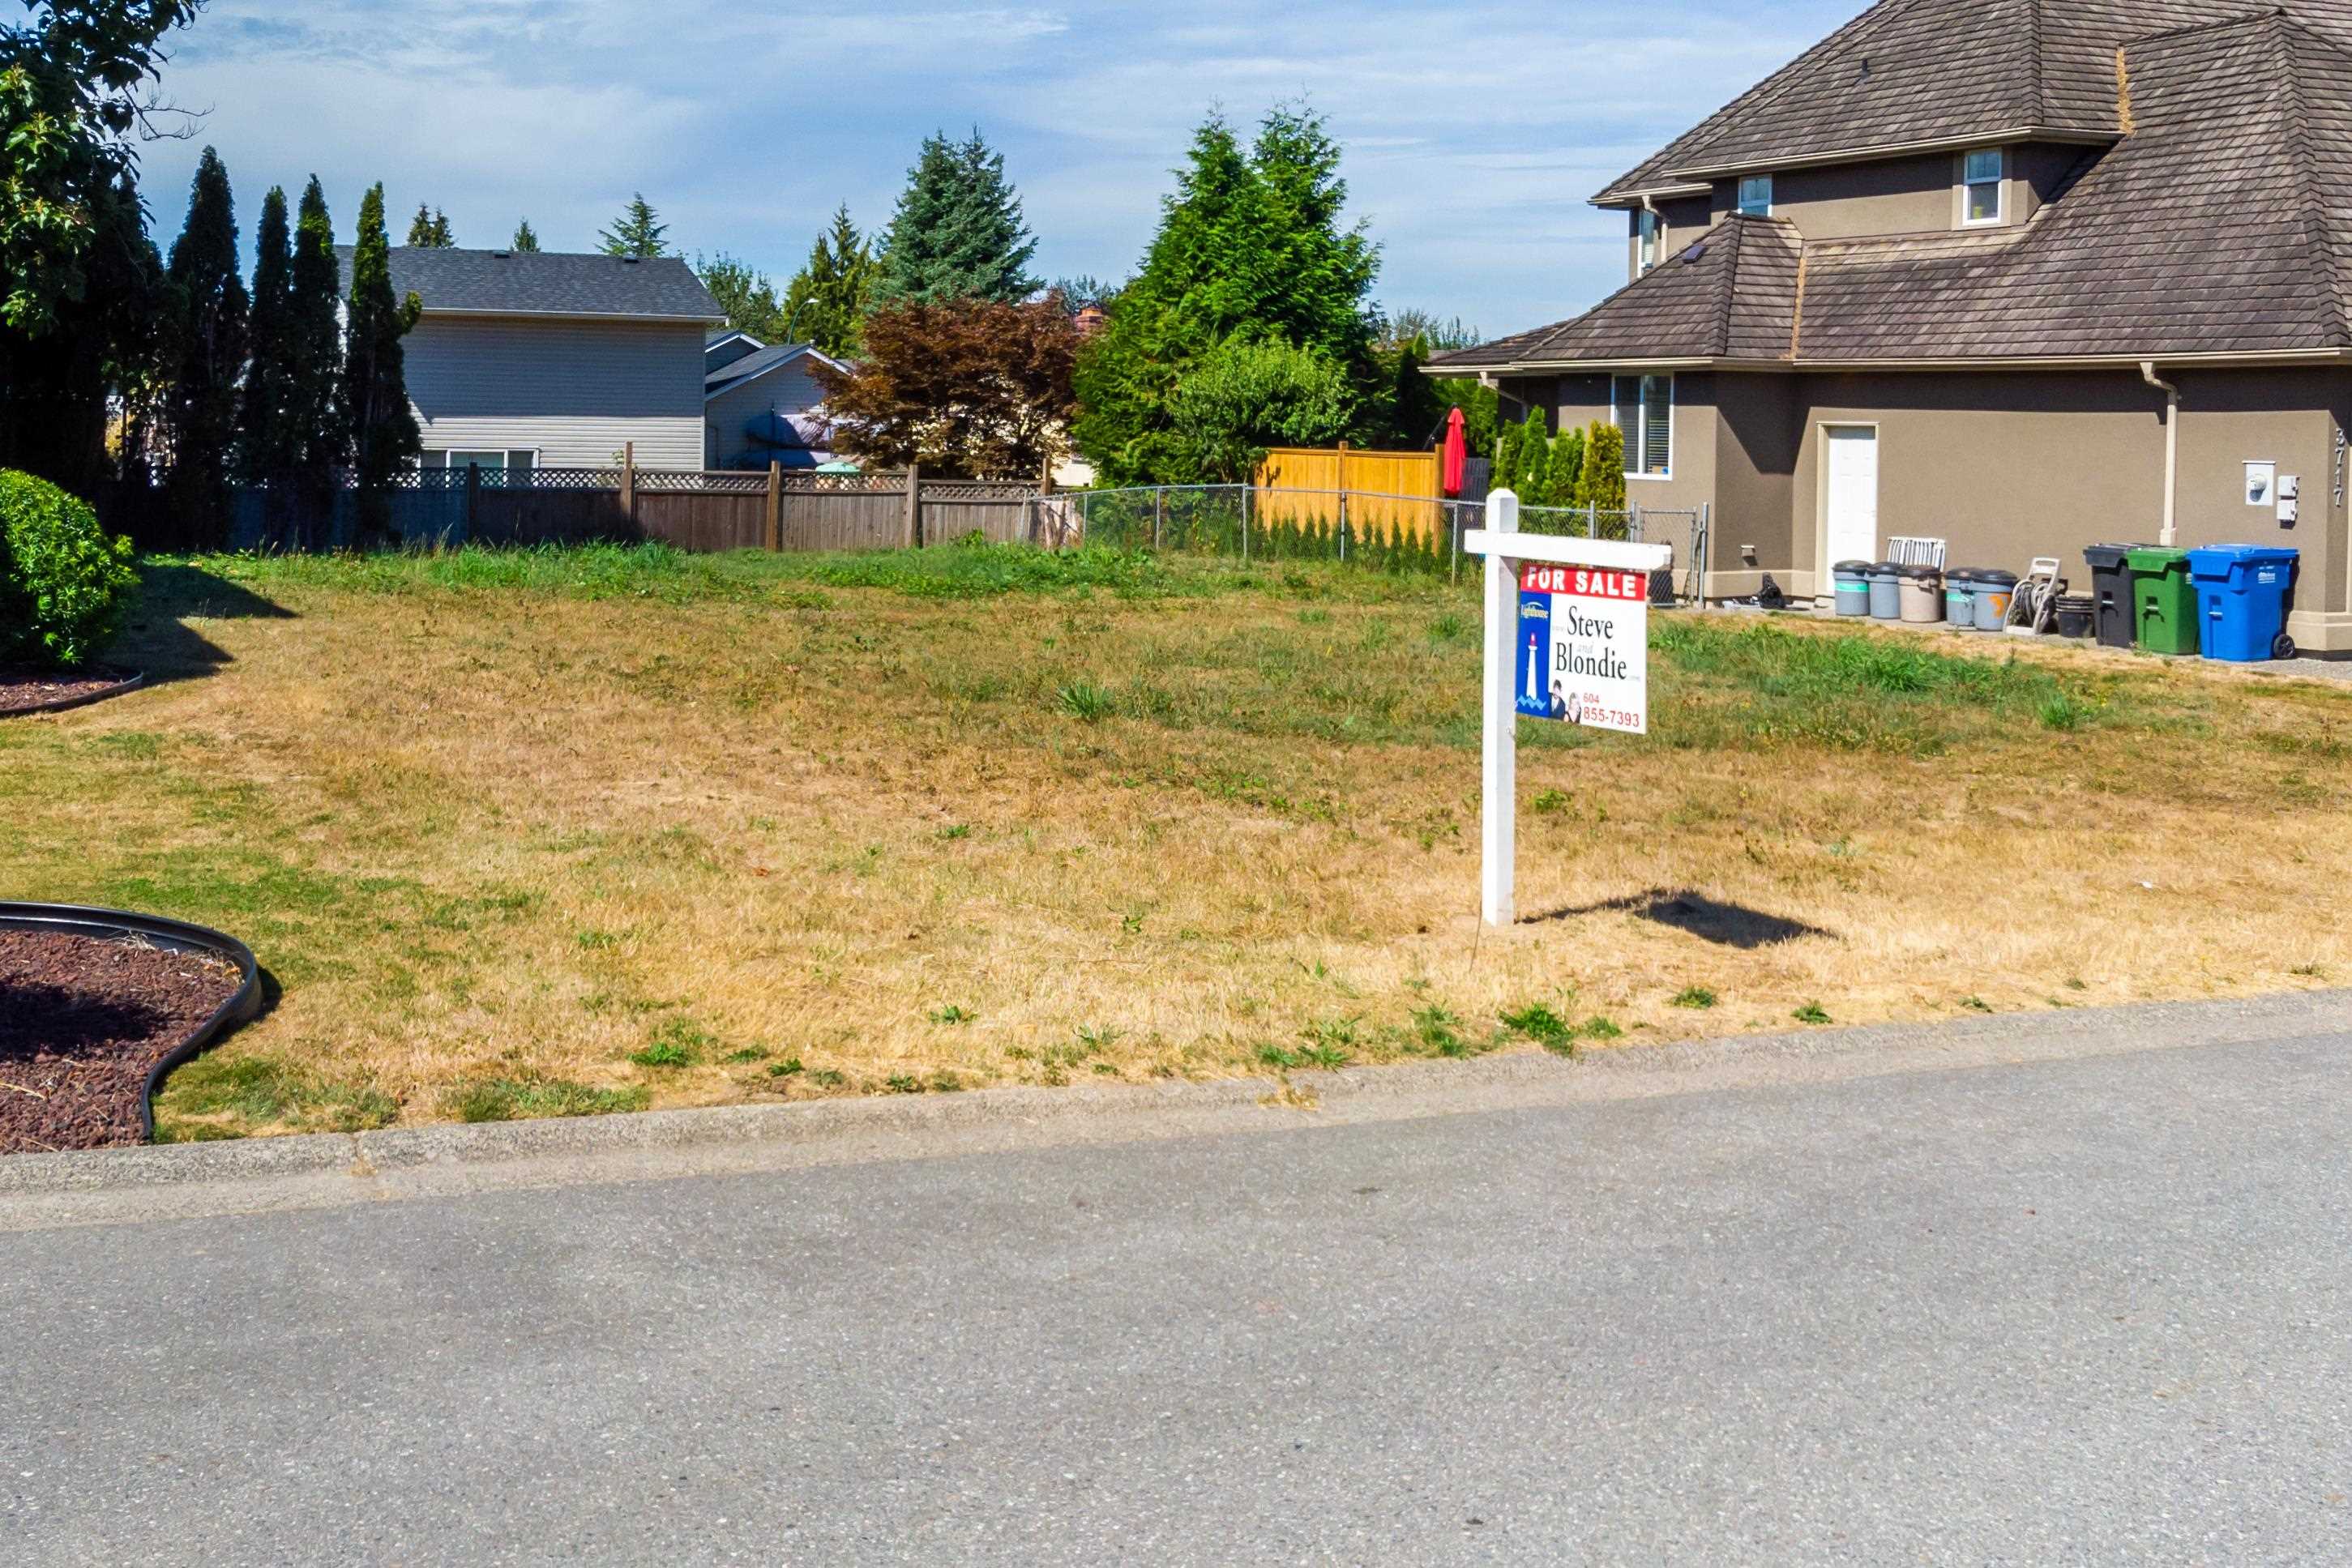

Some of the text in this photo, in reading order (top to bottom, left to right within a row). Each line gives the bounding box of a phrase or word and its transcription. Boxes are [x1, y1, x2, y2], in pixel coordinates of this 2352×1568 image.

[1527, 566, 1636, 597] FOR SALE
[1567, 605, 1614, 639] Steve
[1555, 643, 1627, 680] Blondie
[1583, 693, 1600, 703] 604
[1584, 706, 1640, 728] 855-7393
